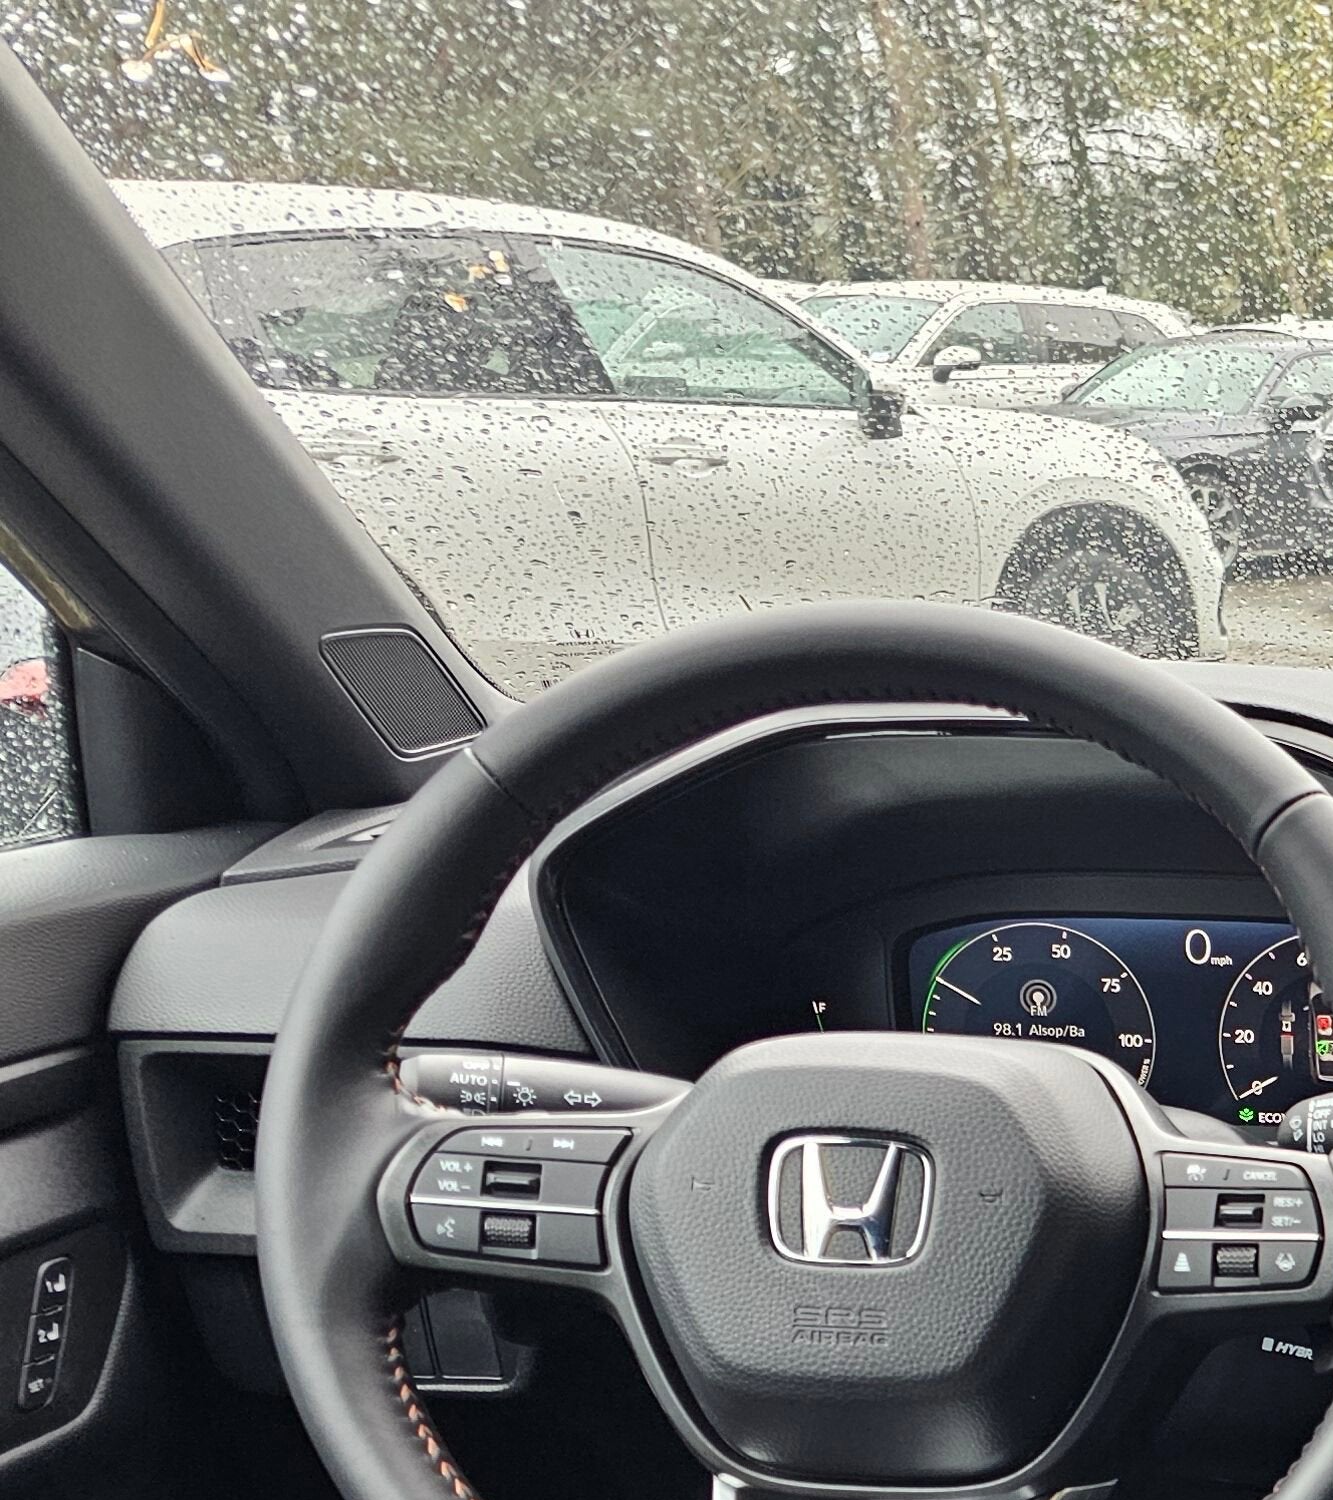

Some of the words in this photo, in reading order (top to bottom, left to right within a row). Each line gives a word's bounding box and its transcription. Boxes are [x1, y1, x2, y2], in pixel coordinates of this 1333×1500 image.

[992, 946, 1013, 962] 25
[1051, 944, 1071, 960] 50
[1185, 928, 1212, 965] 0
[1210, 955, 1233, 968] mph
[1100, 978, 1121, 993] 75
[1252, 981, 1273, 996] 40
[1030, 1005, 1048, 1017] FM
[993, 1022, 1022, 1036] 98.1
[1029, 1024, 1085, 1039] Alsop/Ba
[1234, 1029, 1255, 1044] 20
[1118, 1033, 1144, 1048] 100
[449, 1072, 488, 1086] AUTO
[1313, 1108, 1332, 1120] OFF
[1312, 1119, 1328, 1131] INT
[1312, 1131, 1326, 1143] LO
[1242, 1170, 1278, 1181] CANCEL
[793, 1306, 888, 1329] SRS
[791, 1329, 889, 1347] AIRBAG
[1274, 1341, 1314, 1361] HYBR
